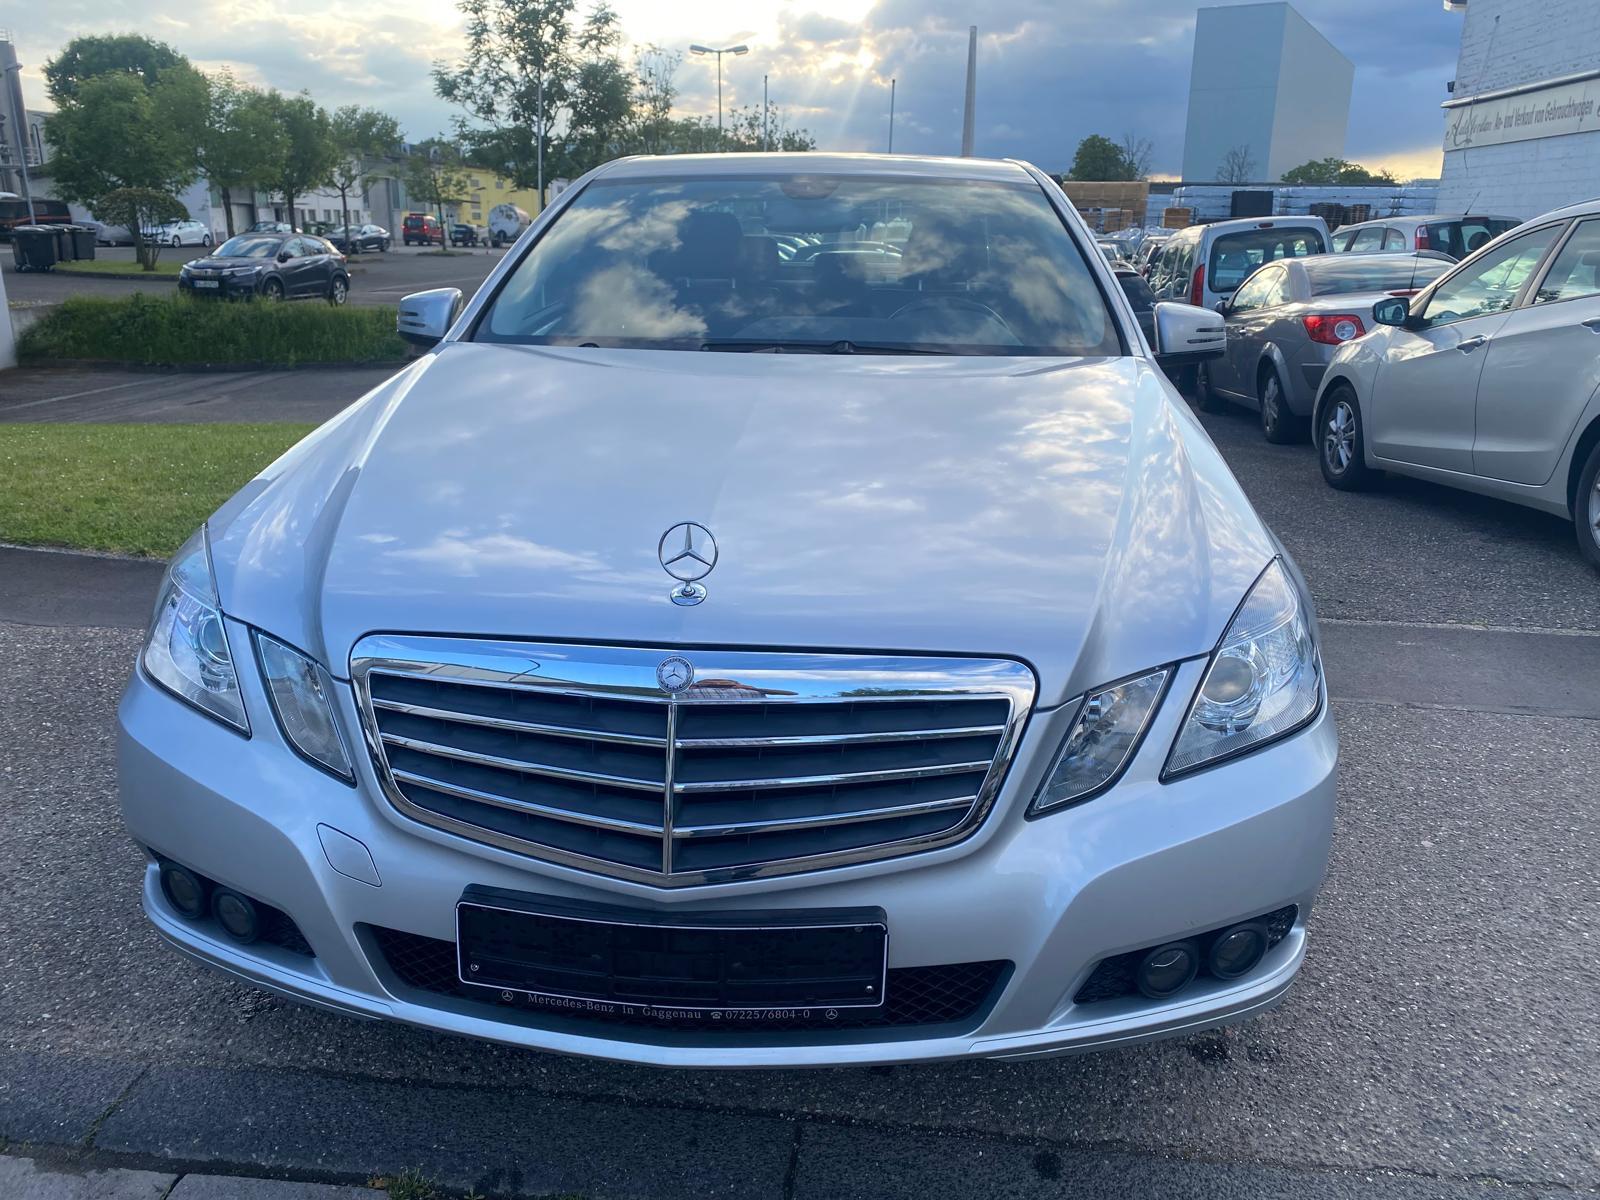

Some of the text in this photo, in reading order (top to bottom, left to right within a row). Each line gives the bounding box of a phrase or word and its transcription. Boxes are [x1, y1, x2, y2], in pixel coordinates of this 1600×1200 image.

[527, 993, 811, 1020] Mercedes-Benz in Gaggenau 07225/6804-0
